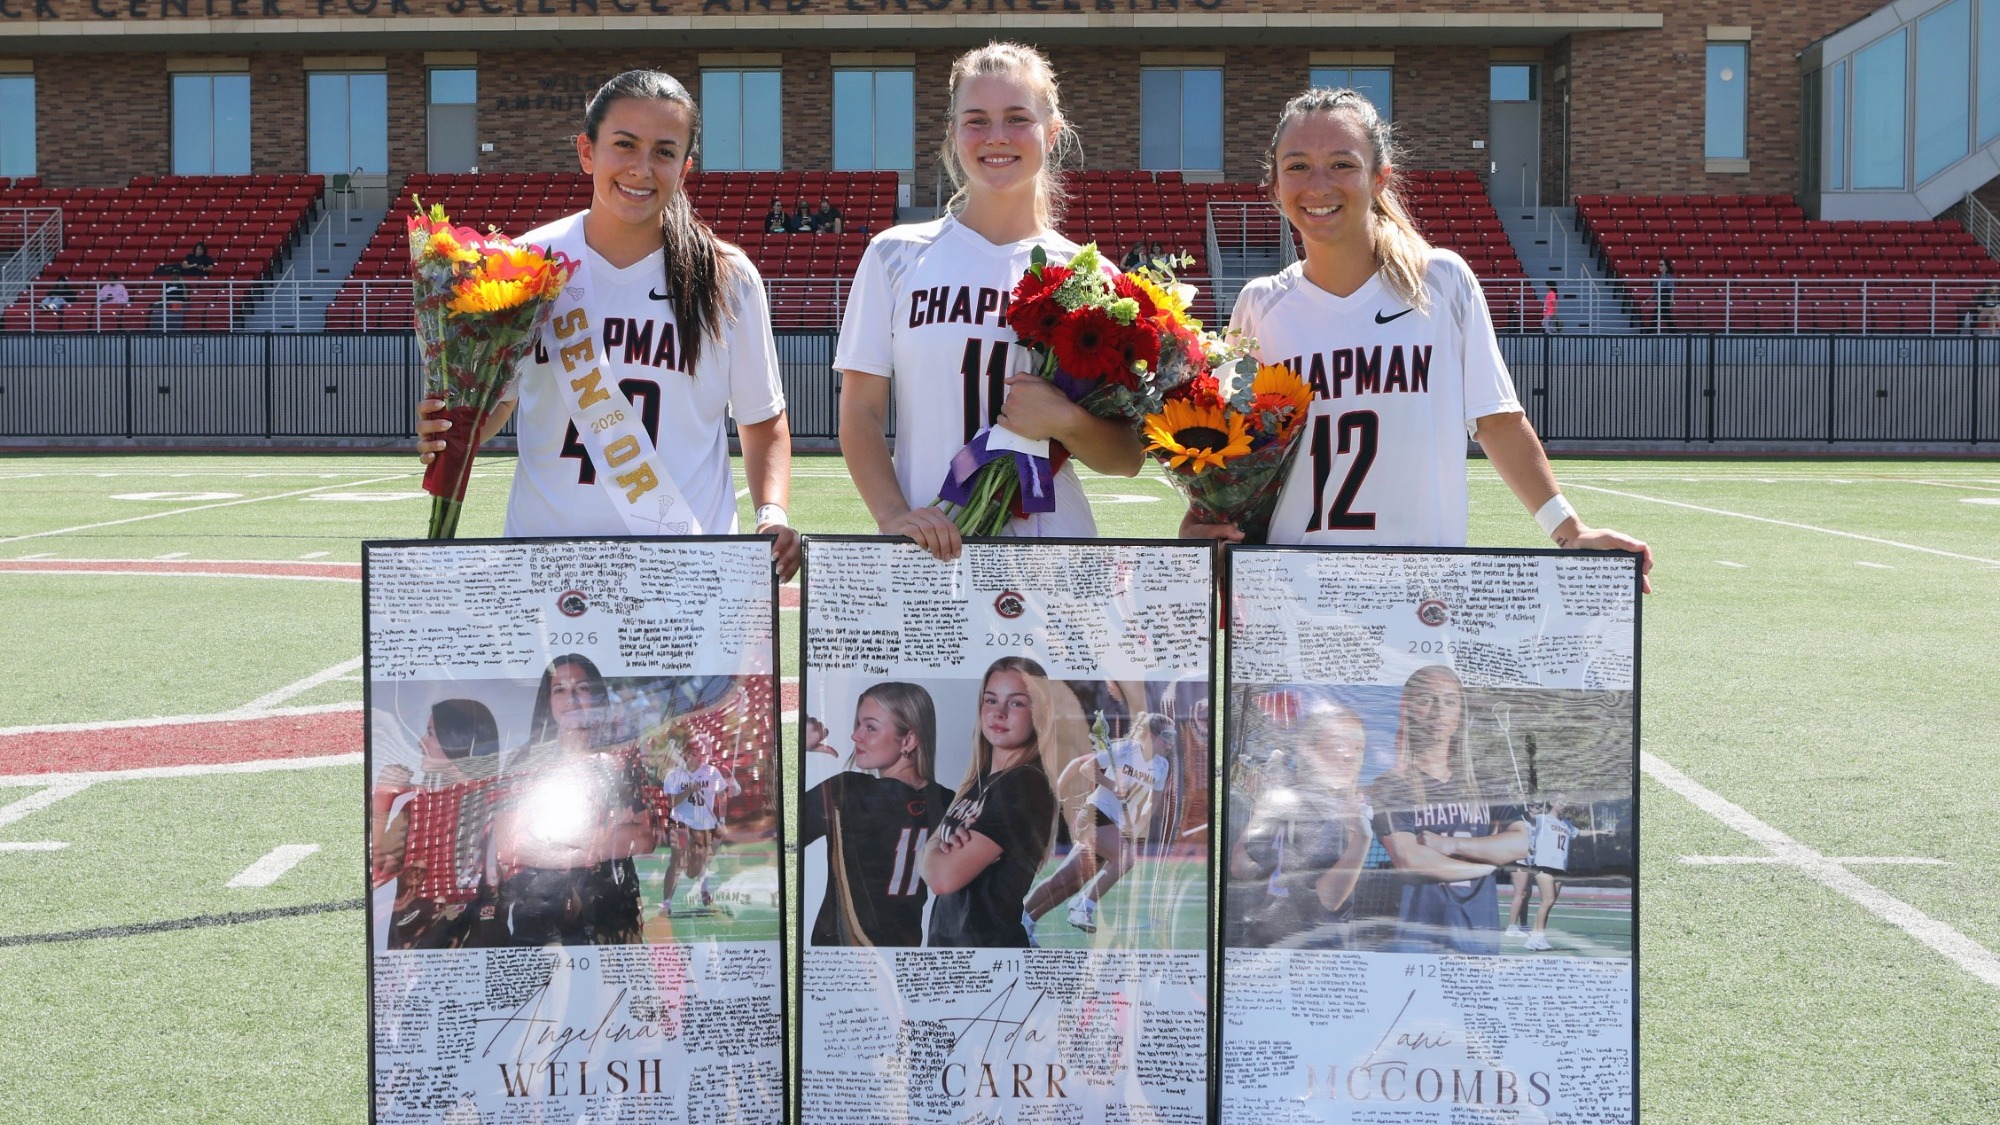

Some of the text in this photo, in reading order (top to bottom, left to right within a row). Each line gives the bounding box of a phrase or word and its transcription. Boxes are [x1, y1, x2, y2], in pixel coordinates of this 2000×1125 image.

[92, 0, 283, 18] CENTER
[909, 286, 1010, 329] CHAP
[590, 409, 625, 434] 2026
[1304, 409, 1379, 533] 12
[549, 632, 598, 645] 2026
[985, 633, 1034, 646] 2026
[1408, 641, 1457, 654] 2026
[1413, 802, 1491, 827] CHAPMAN
[1557, 833, 1567, 851] 12
[887, 827, 929, 896] 11
[551, 957, 590, 971] #40
[992, 959, 1020, 973] #11
[1404, 964, 1437, 977] #12
[472, 976, 658, 1073] Angelina
[938, 977, 1046, 1066] Ada
[1359, 988, 1452, 1072] Lani
[497, 1059, 663, 1098] WELSH
[941, 1063, 1068, 1098] CARR
[1306, 1064, 1551, 1107] MCCOMBS
